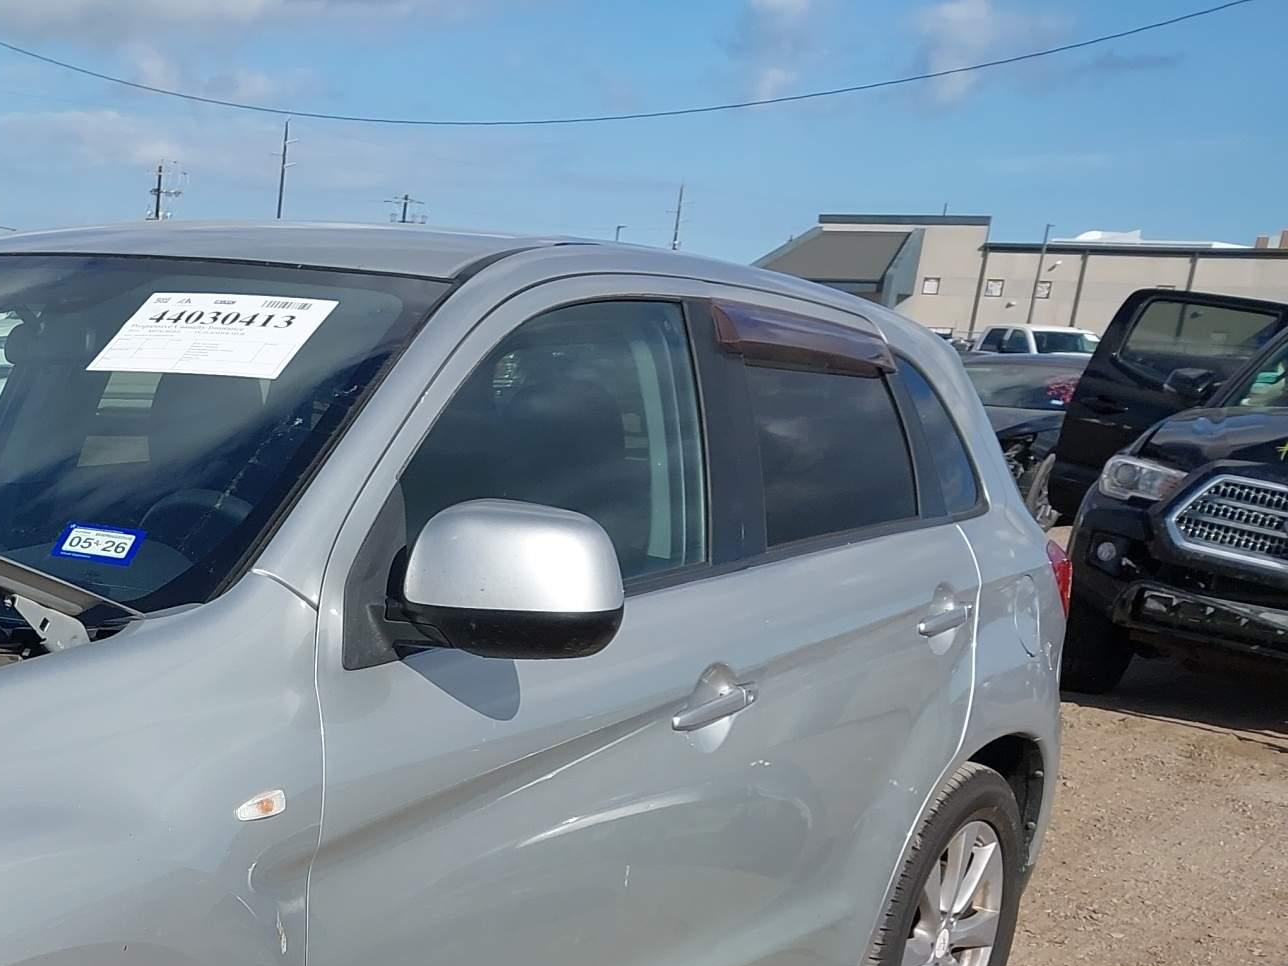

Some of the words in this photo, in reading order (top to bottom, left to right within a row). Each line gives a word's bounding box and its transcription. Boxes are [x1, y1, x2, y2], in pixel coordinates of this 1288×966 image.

[149, 310, 296, 328] 44030413
[69, 536, 94, 549] 05
[101, 540, 128, 554] 26
